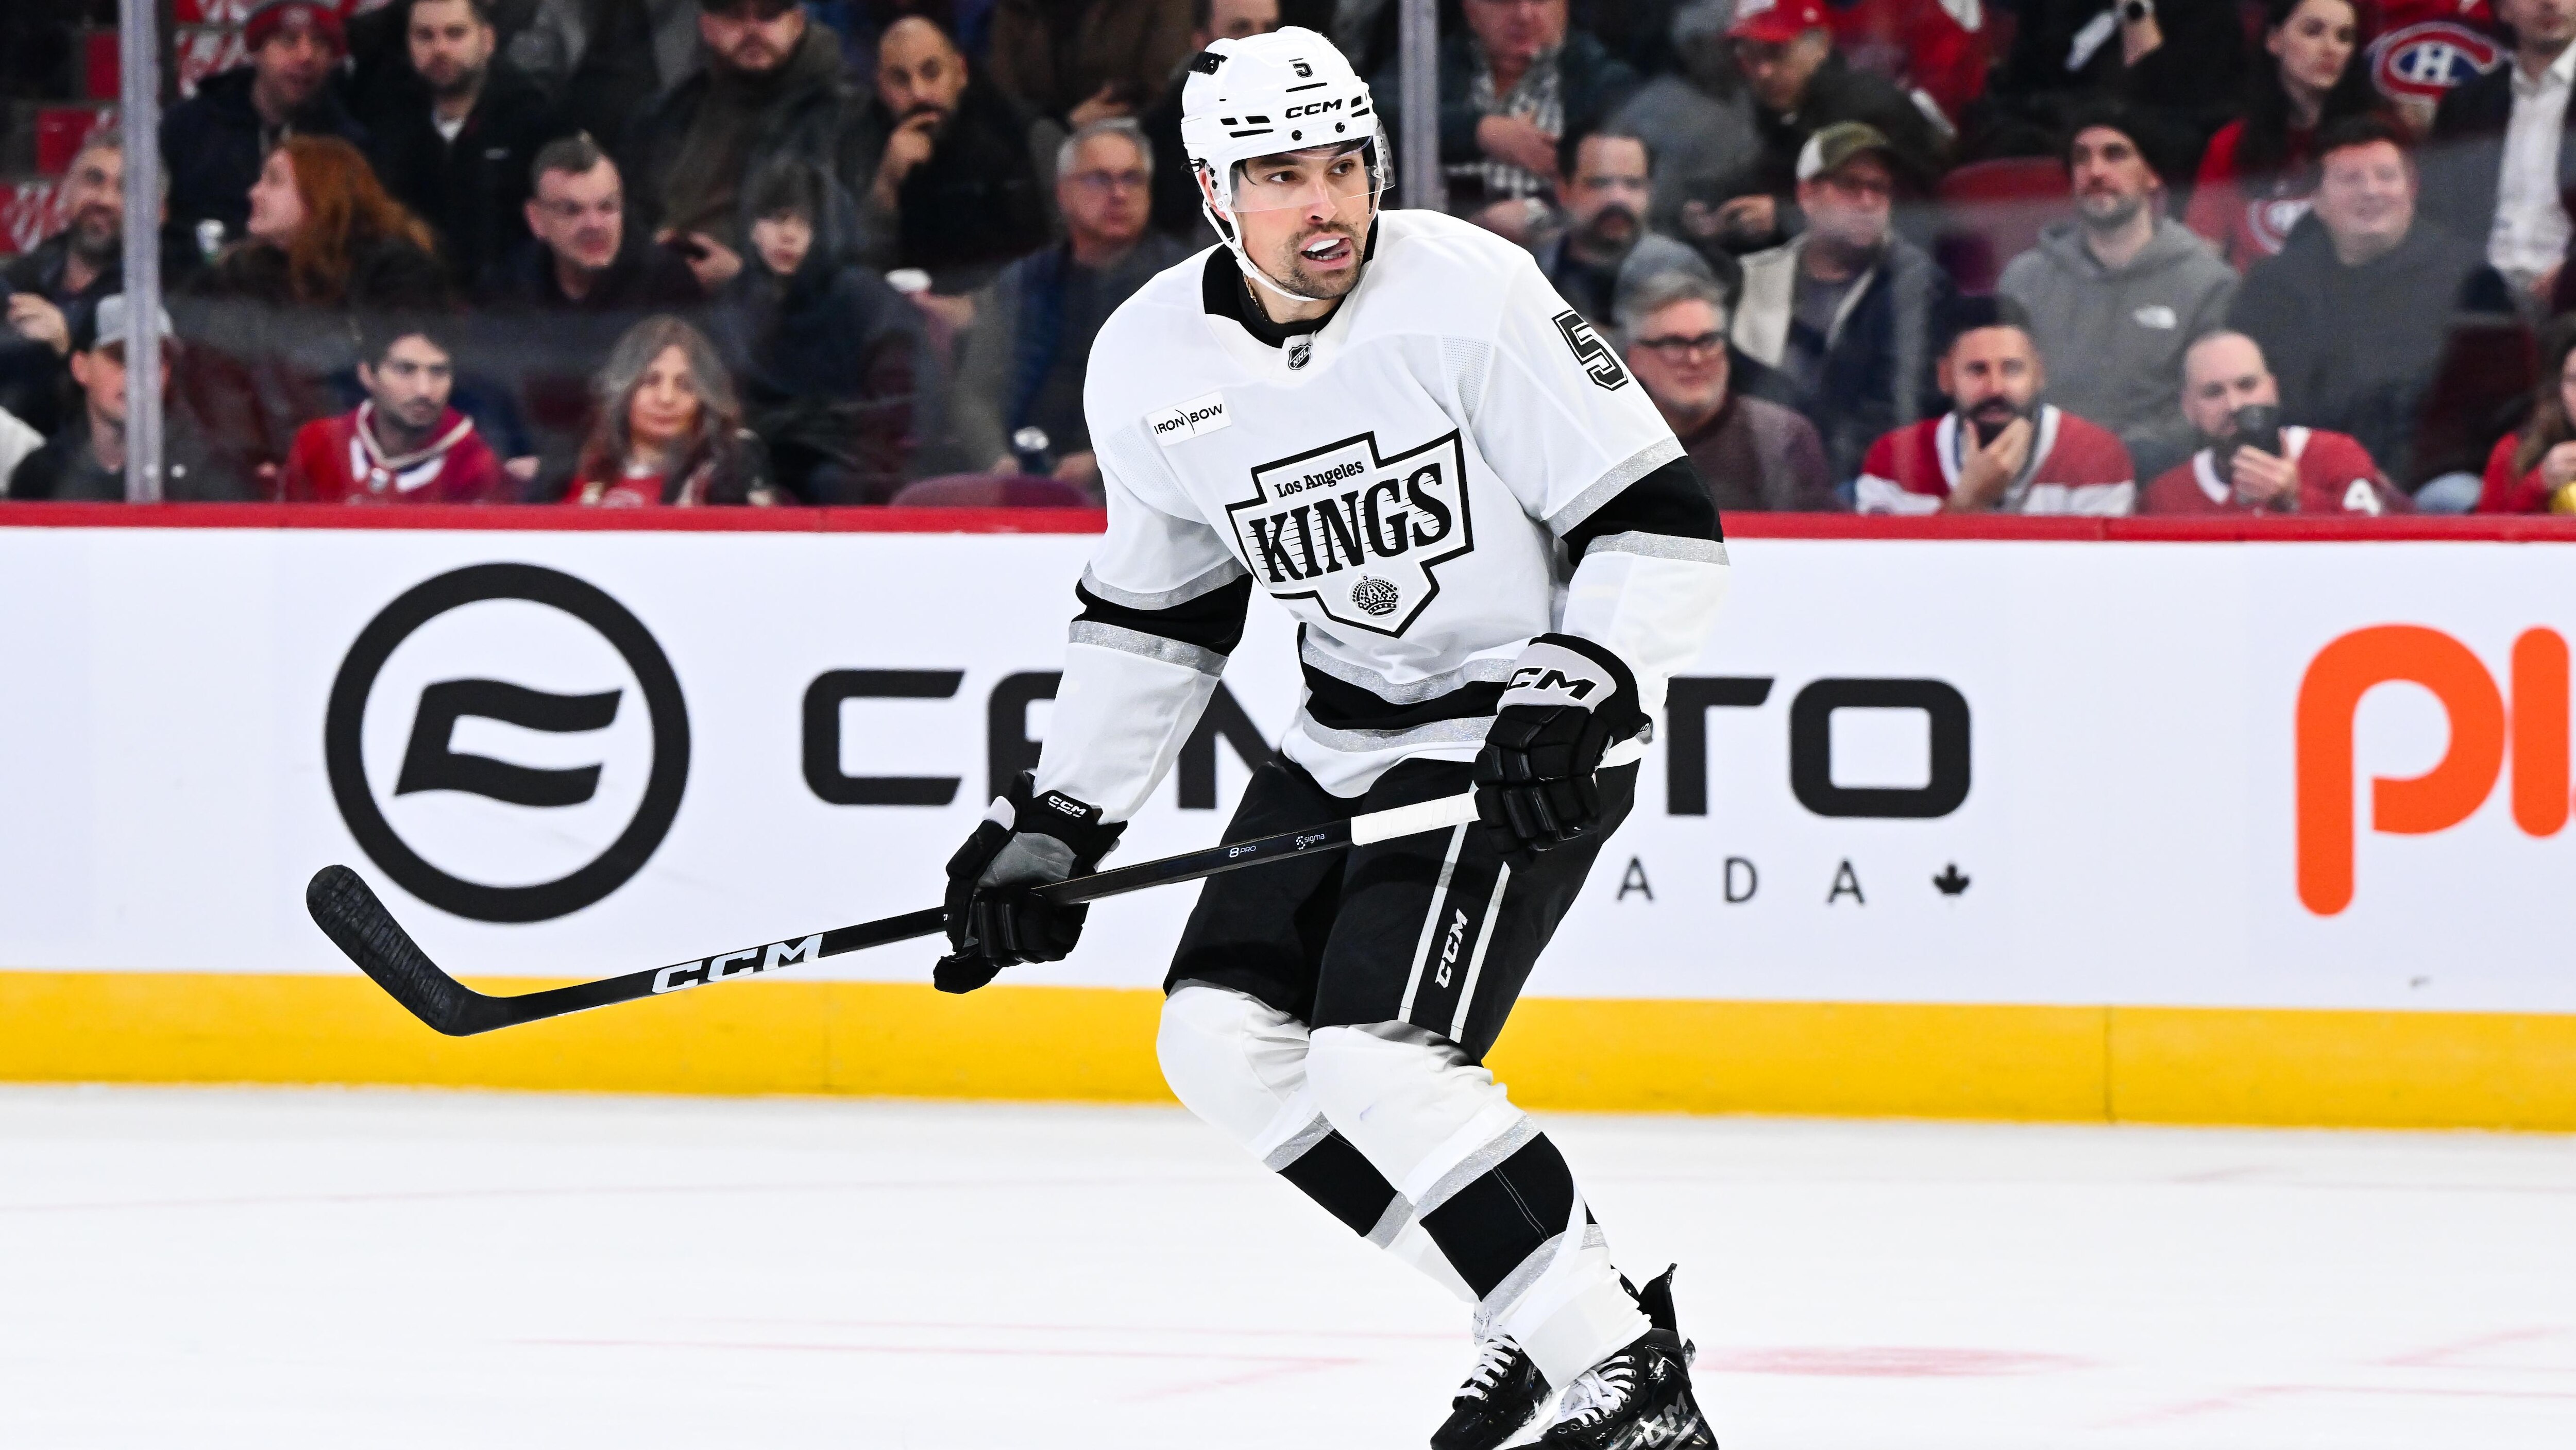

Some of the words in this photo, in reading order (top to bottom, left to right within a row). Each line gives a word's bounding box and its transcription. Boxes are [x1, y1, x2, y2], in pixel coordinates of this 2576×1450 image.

[1293, 62, 1313, 78] 5
[1285, 98, 1343, 119] CCM
[1292, 348, 1309, 367] NHL
[1551, 309, 1629, 392] 5
[1154, 416, 1185, 434] IRON
[1190, 403, 1223, 423] BOW
[1274, 480, 1303, 498] Los
[1303, 461, 1365, 490] Angeles
[1247, 462, 1452, 583] KINGS
[1505, 667, 1598, 701] CM
[1048, 795, 1087, 815] CCM
[1229, 847, 1240, 858] 8
[1240, 846, 1257, 854] PRO
[1304, 833, 1325, 844] sigma
[651, 933, 824, 994] CCM
[1435, 908, 1468, 988] CCM
